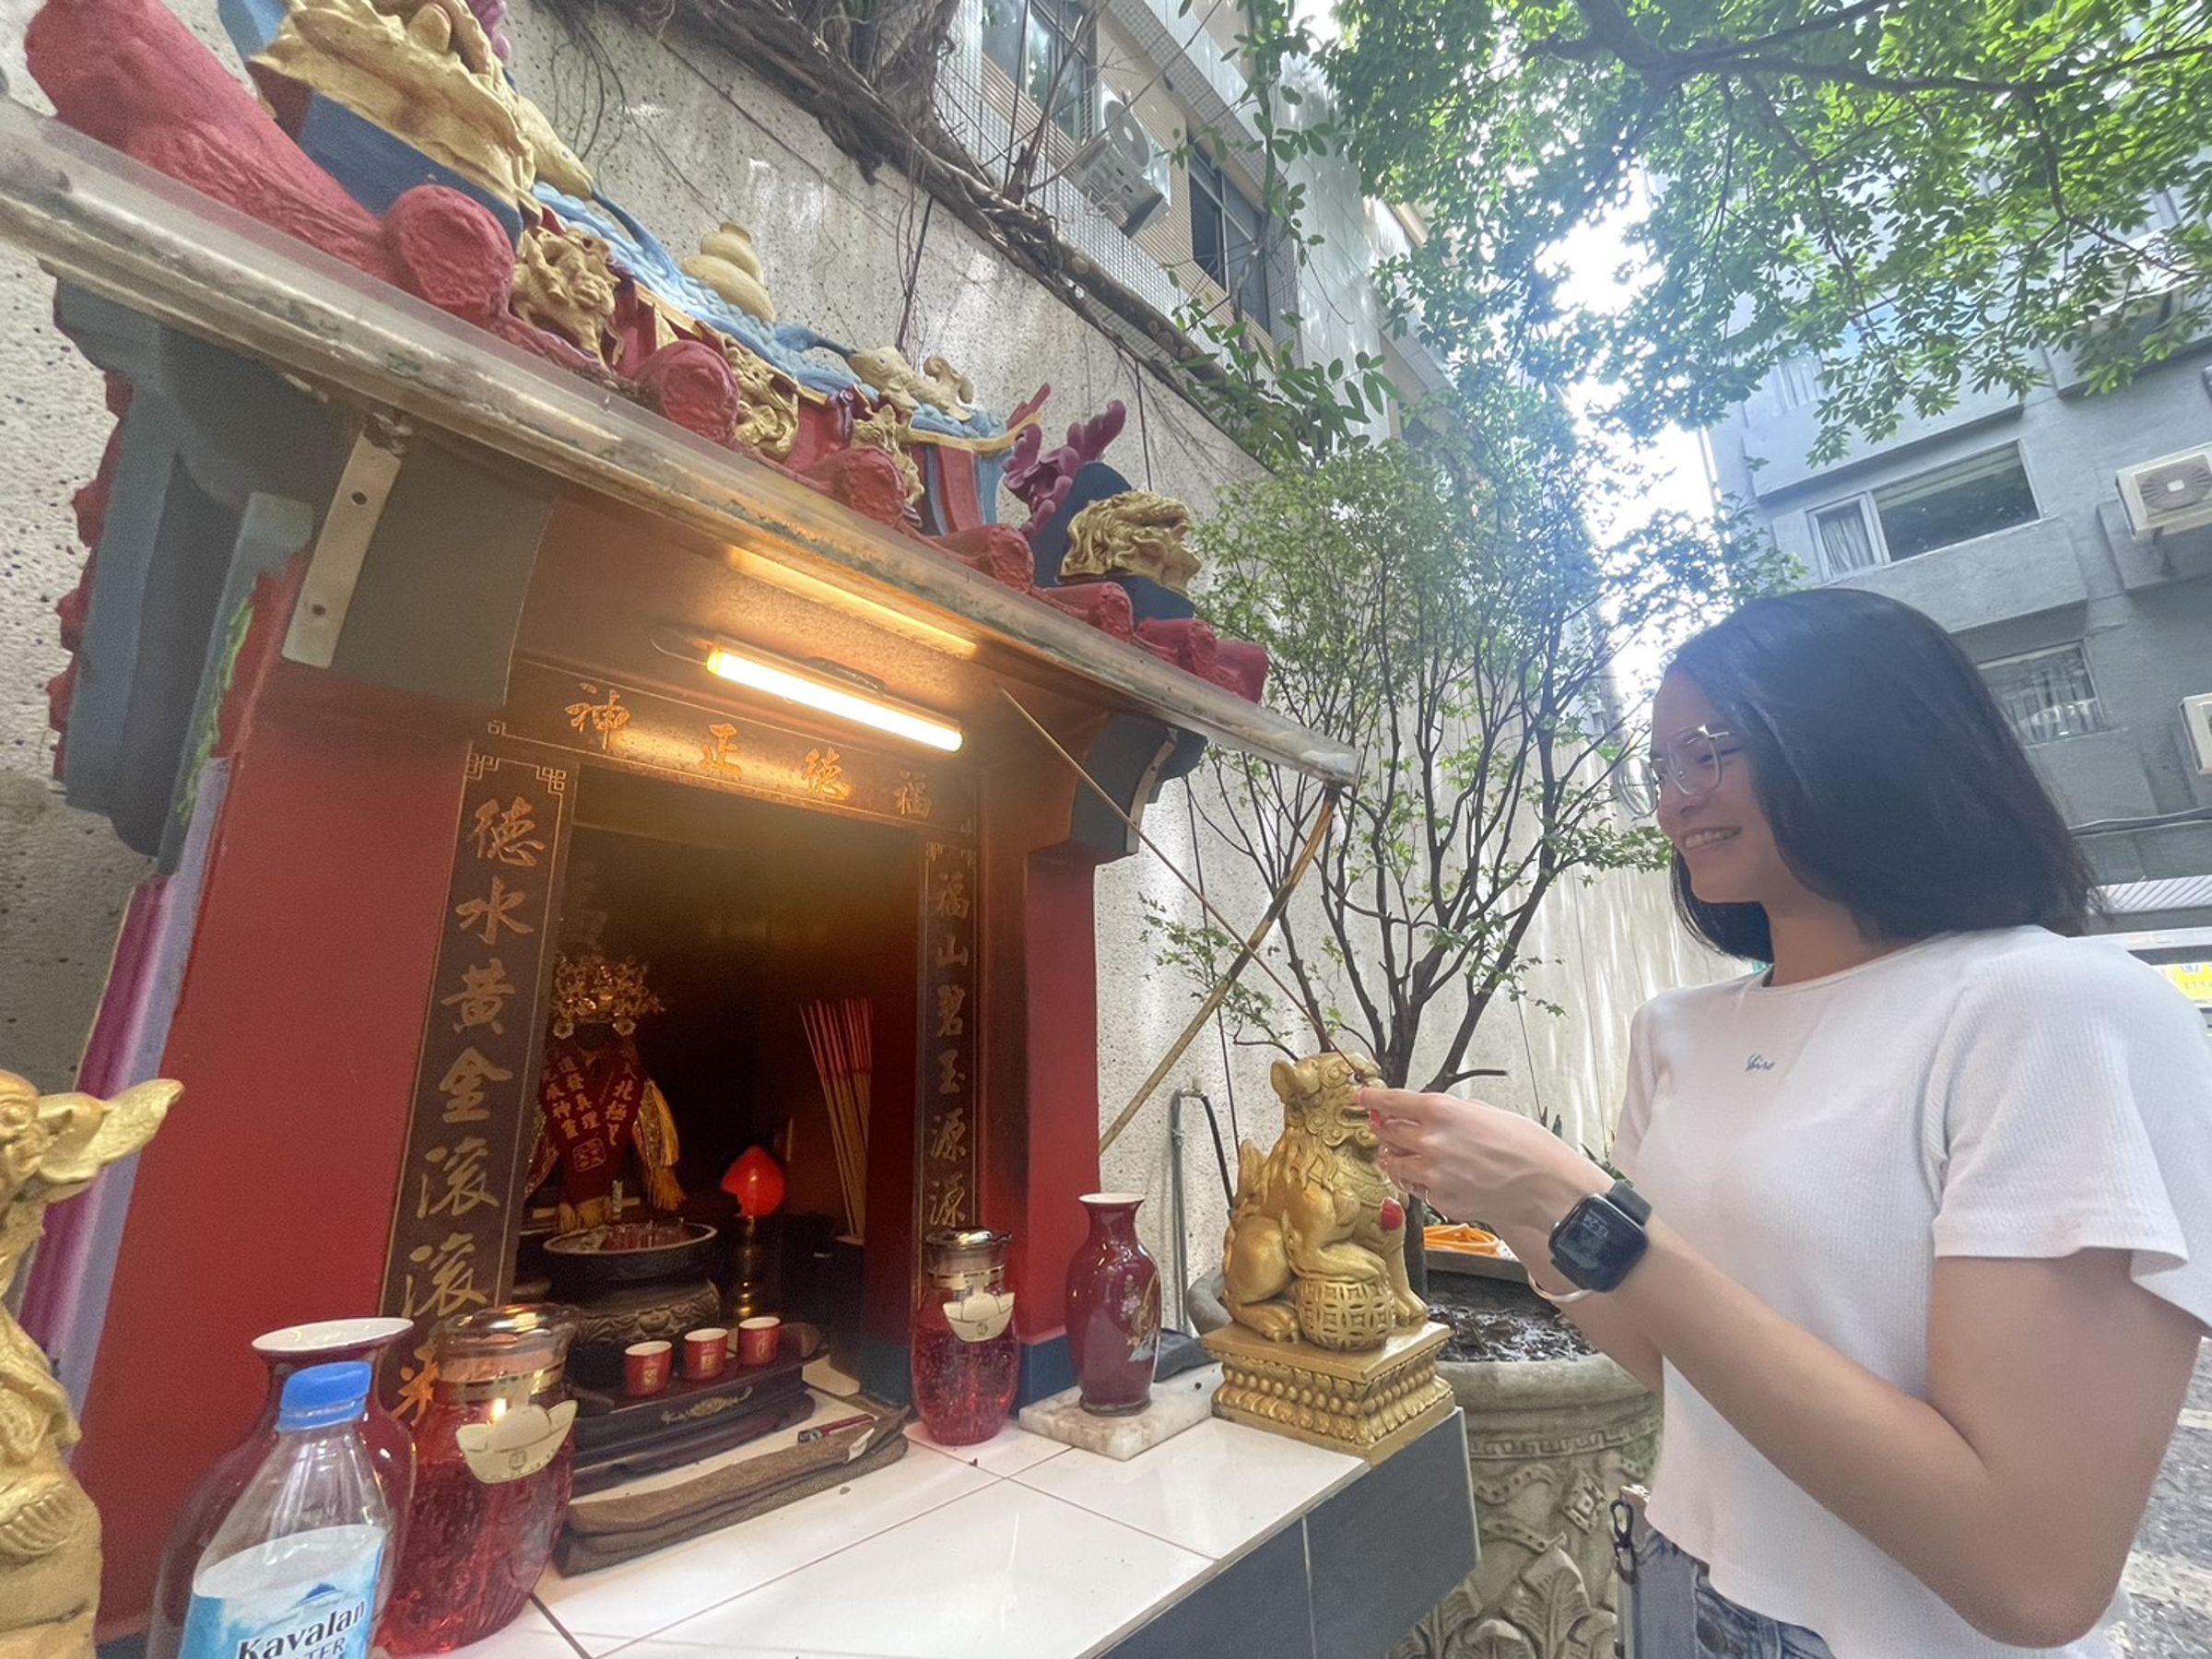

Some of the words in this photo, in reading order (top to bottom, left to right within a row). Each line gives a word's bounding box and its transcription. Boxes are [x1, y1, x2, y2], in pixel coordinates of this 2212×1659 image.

[564, 682, 933, 819] 福德正神
[238, 1600, 366, 1659] Kavalan
